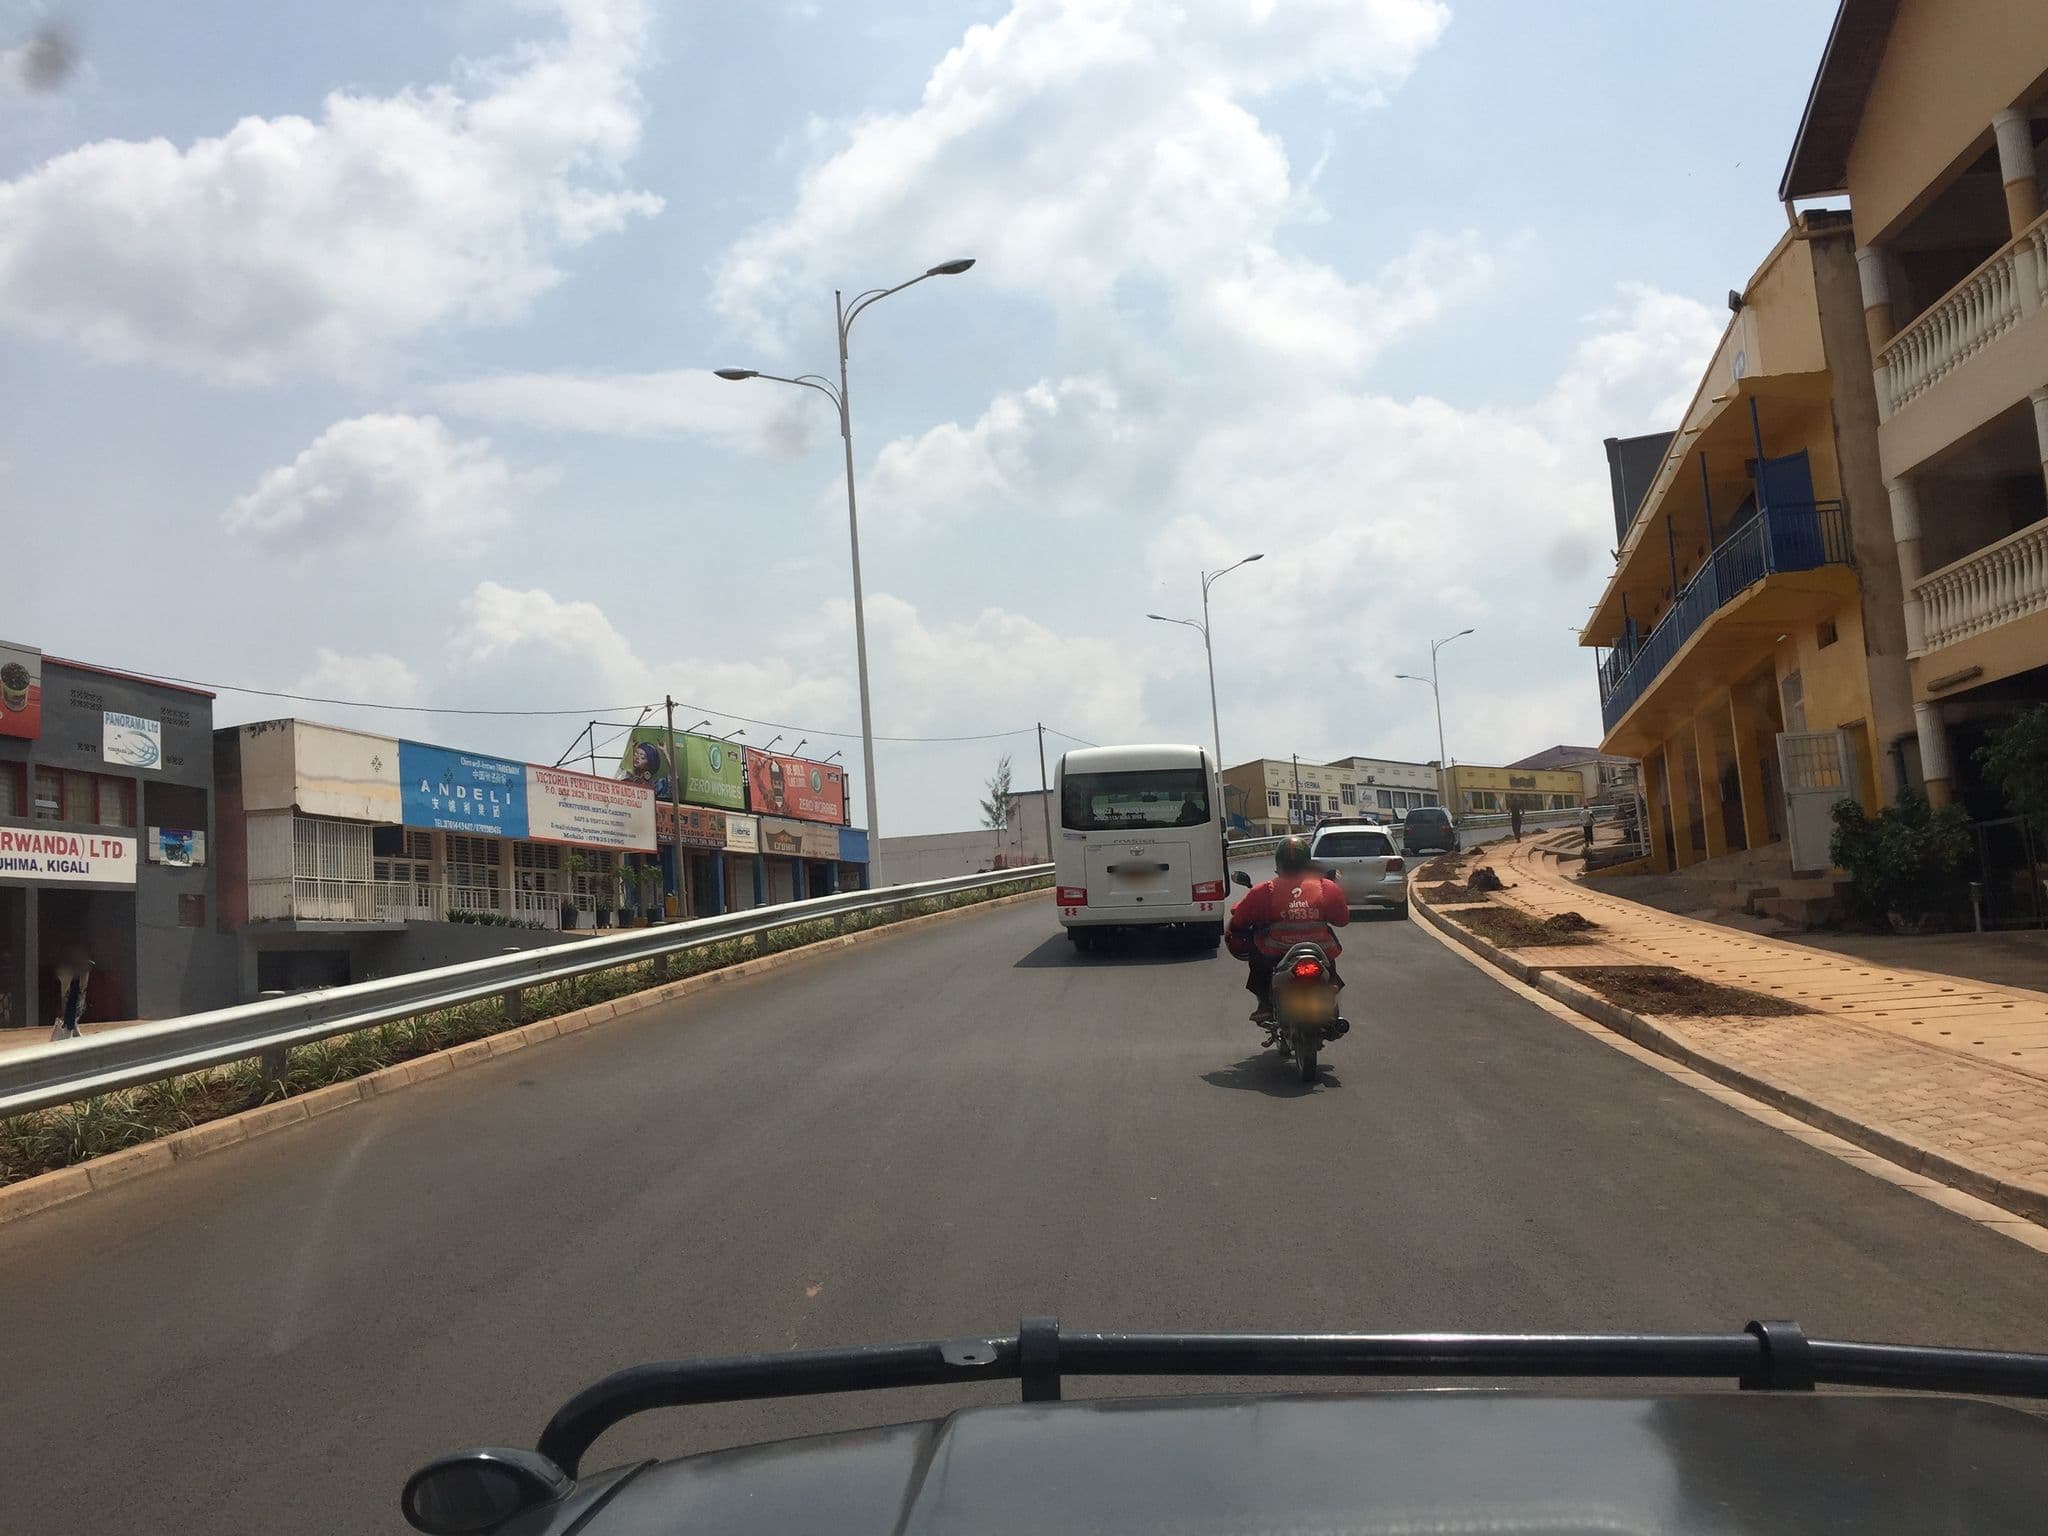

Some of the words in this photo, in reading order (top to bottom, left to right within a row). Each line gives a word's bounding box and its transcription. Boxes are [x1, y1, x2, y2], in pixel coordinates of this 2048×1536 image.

[105, 713, 145, 730] PANORAMA
[421, 780, 511, 805] ANDELI
[536, 771, 569, 787] VICTORIA
[570, 777, 610, 794] FURNITURES
[611, 785, 636, 799] RWANDA
[637, 789, 648, 801] LTD
[689, 777, 711, 793] ZERO
[712, 782, 742, 800] WORRIES
[799, 798, 814, 812] ZERO
[814, 801, 838, 816] WORRIES
[47, 859, 90, 874] KIGALI
[1289, 900, 1310, 909] airtel
